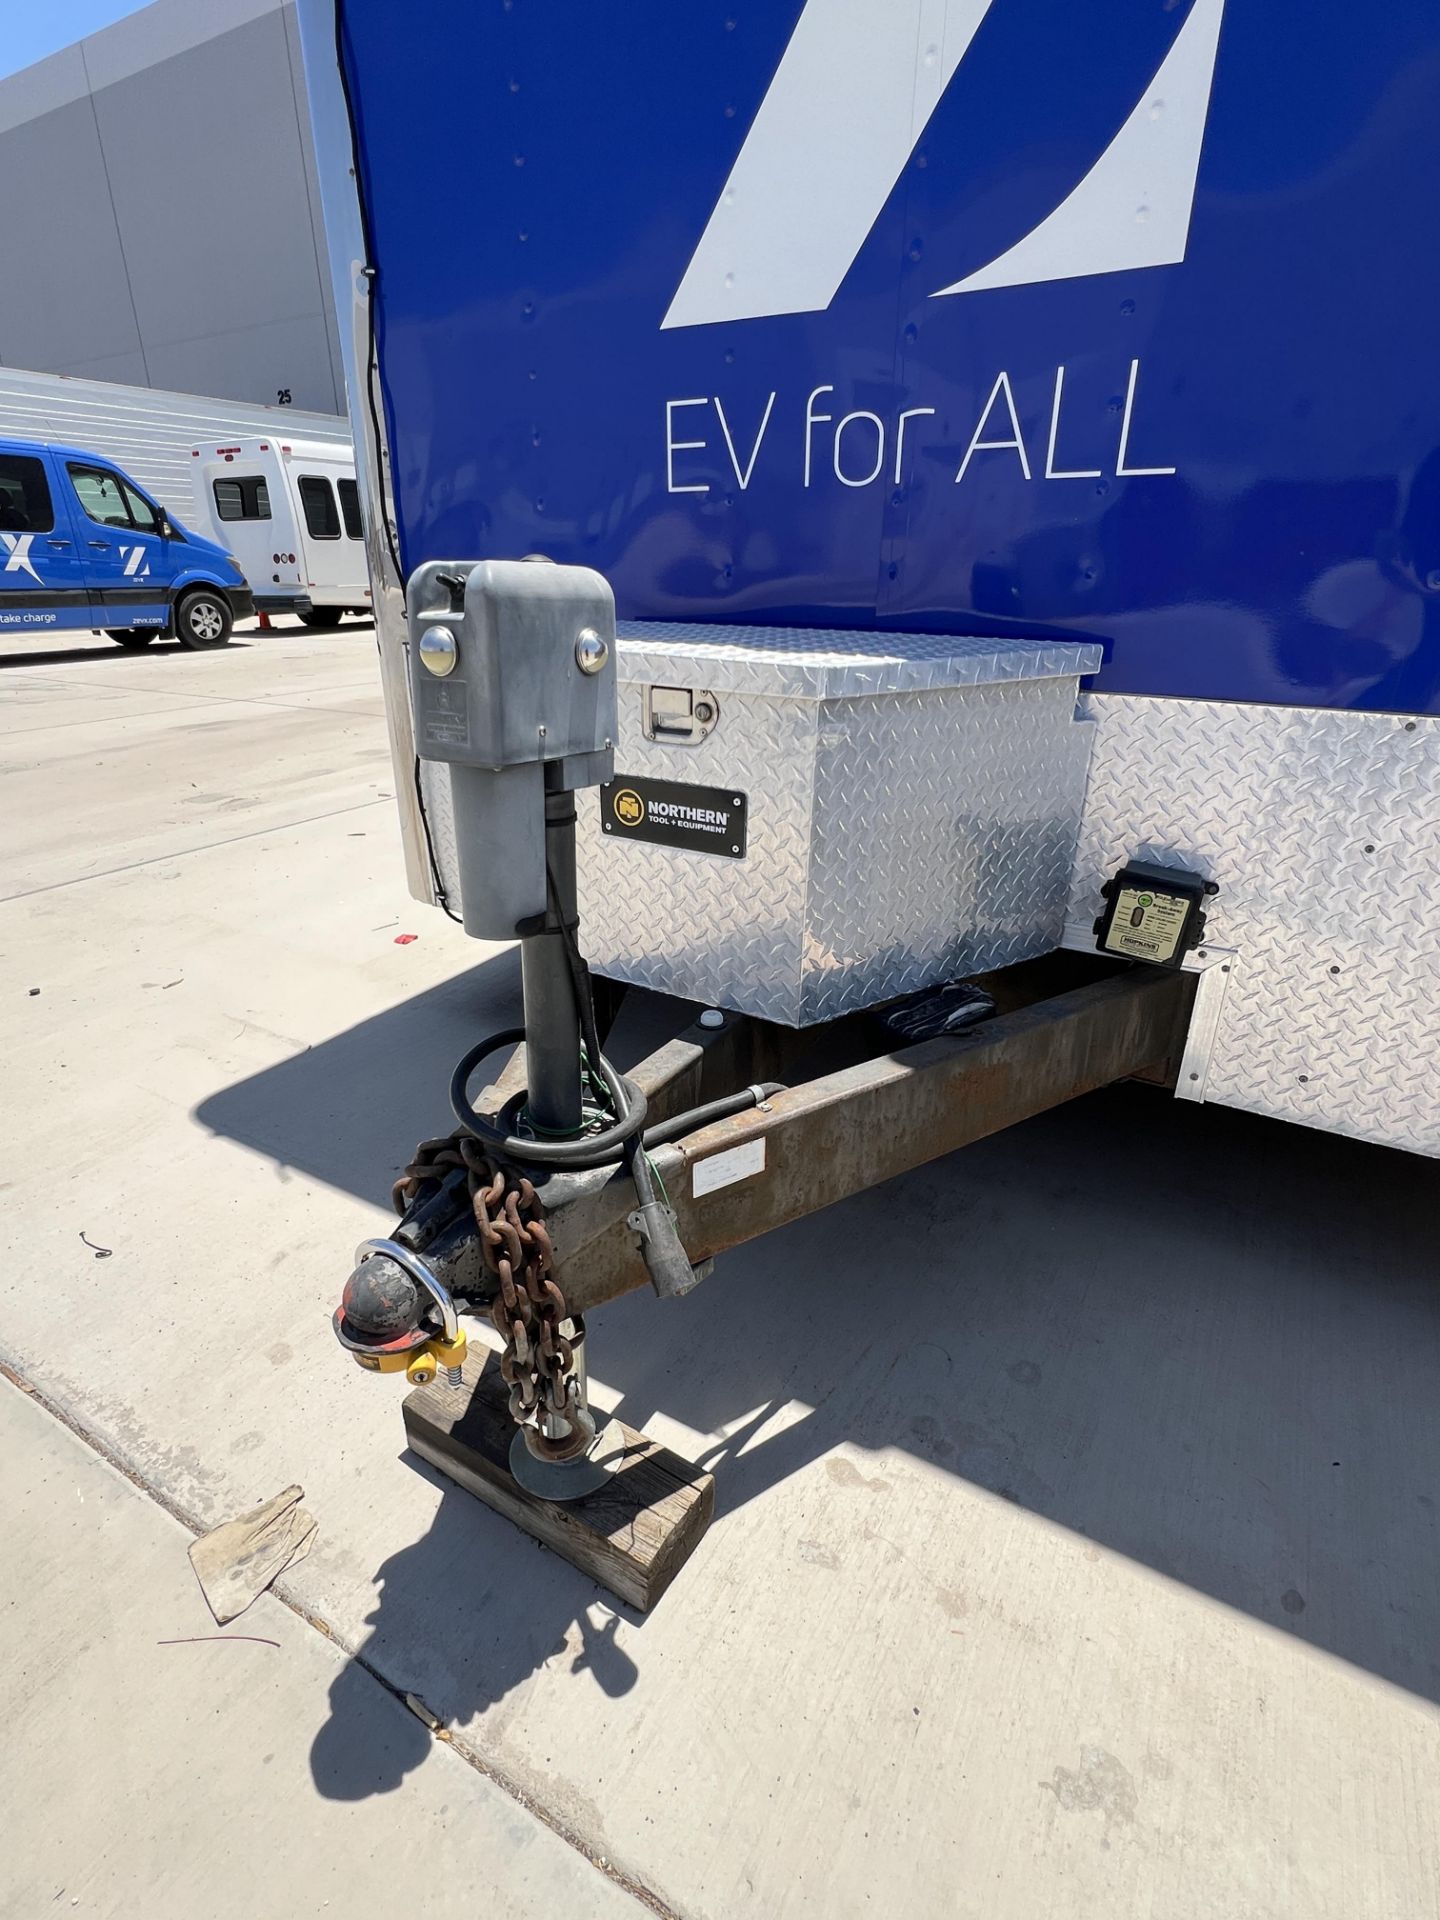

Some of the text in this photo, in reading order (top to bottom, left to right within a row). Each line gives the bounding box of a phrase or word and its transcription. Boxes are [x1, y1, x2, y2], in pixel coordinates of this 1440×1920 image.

[277, 389, 292, 405] 25
[665, 359, 1176, 493] EV for ALL
[0, 613, 56, 624] take charge
[649, 815, 669, 825] TOOL
[677, 821, 727, 834] EQUIPMENT
